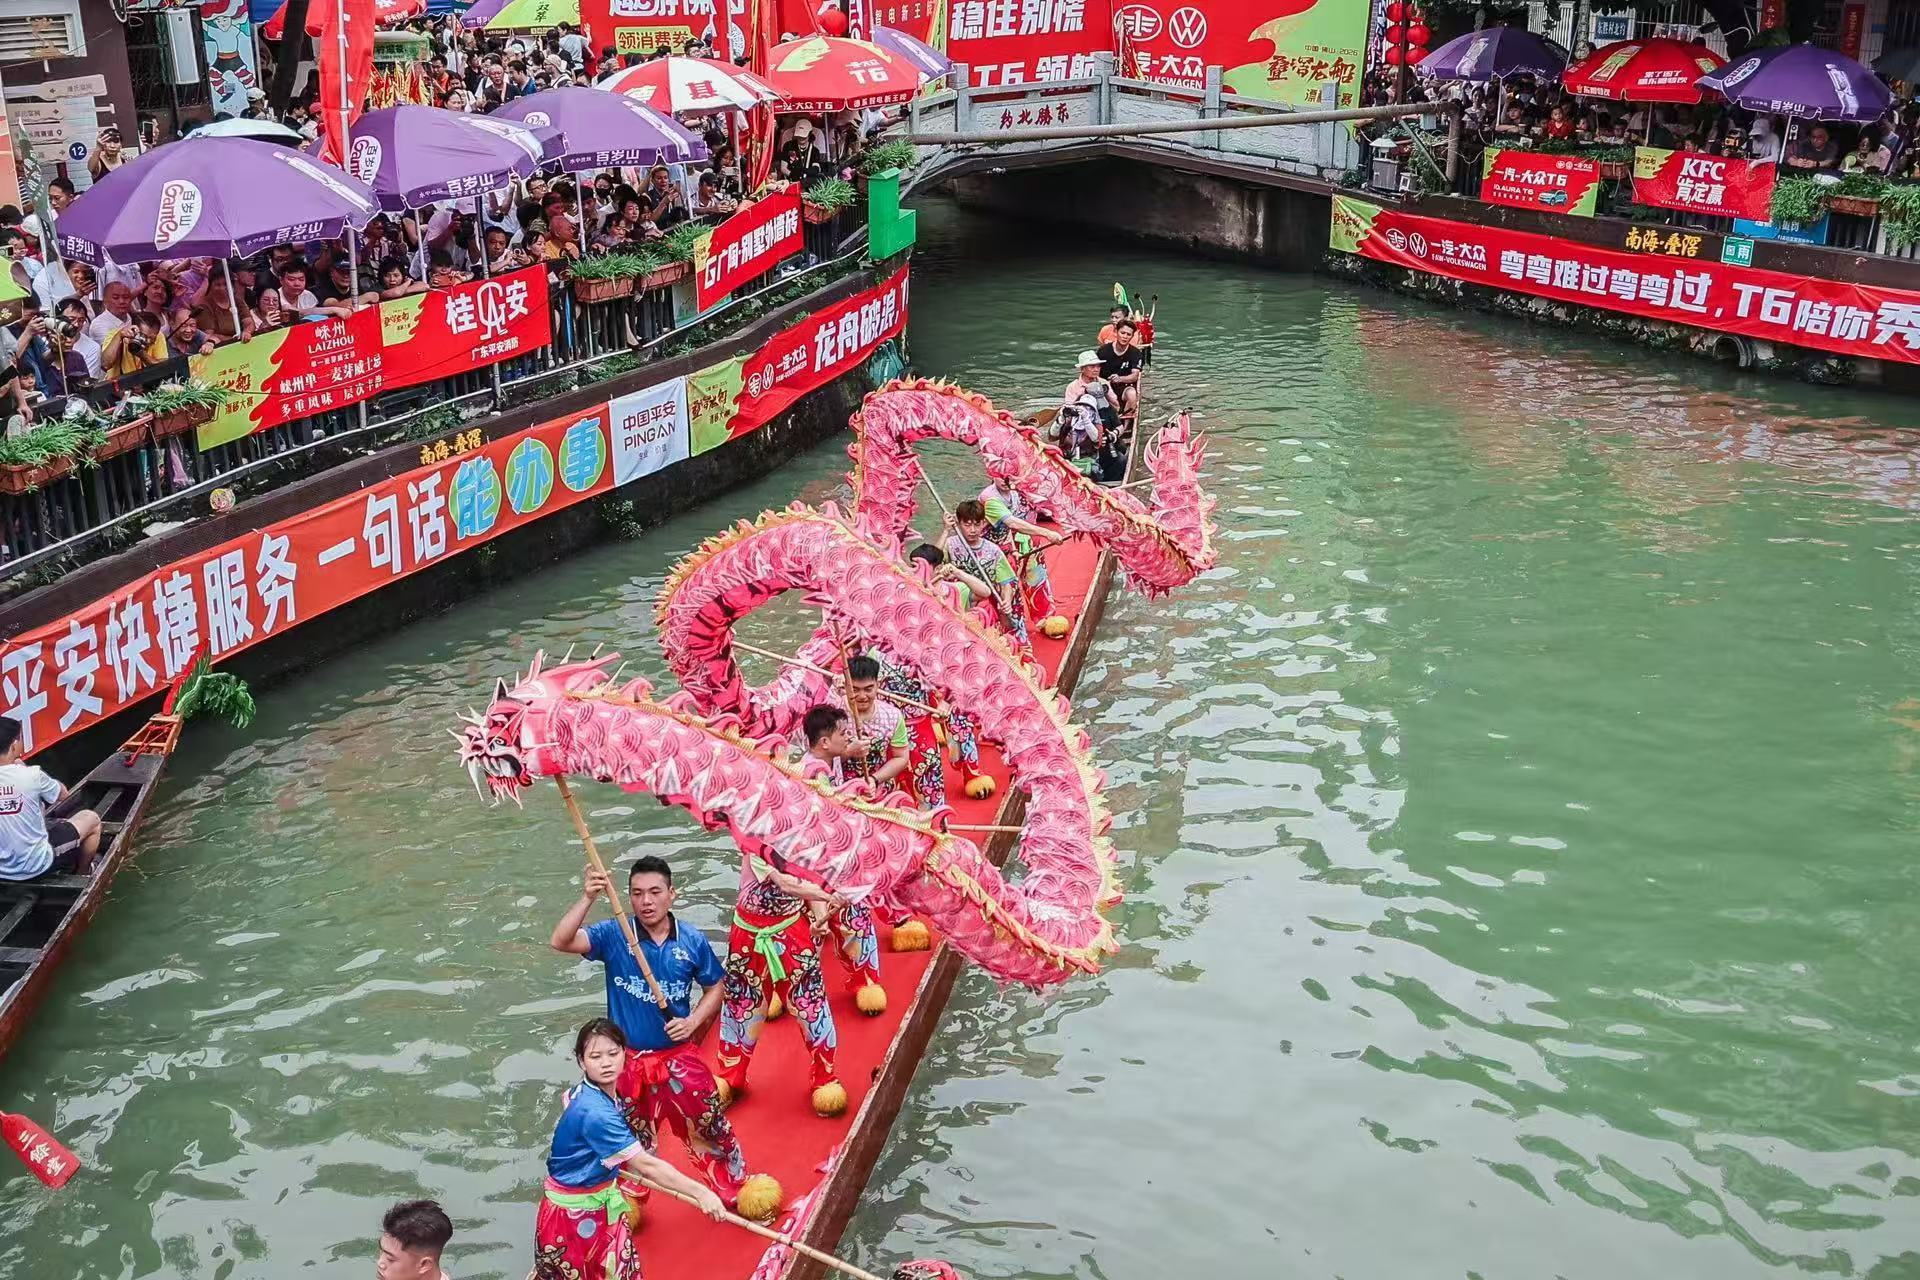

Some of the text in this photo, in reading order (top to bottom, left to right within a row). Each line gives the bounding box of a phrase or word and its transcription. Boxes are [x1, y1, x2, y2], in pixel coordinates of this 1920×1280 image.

[950, 0, 1085, 40] 稳住别慌
[848, 67, 889, 84] T6
[1137, 53, 1204, 78] 汽-大众
[1143, 76, 1204, 90] OLKSWAGEN
[816, 102, 834, 110] T6
[1304, 88, 1353, 107] 漂赛
[1770, 100, 1806, 113] 百岁山
[596, 149, 640, 162] 百岁山
[1495, 167, 1568, 187] 一汽-大众T6
[1680, 158, 1726, 181] KFC
[447, 173, 495, 193] 百岁山
[178, 190, 196, 226] 百岁山
[275, 221, 324, 240] 百岁山
[66, 235, 95, 255] 百岁山
[1430, 239, 1486, 262] 一汽-大众
[308, 335, 355, 354] LAIZHOU
[622, 400, 676, 431] 中国平安
[1, 417, 602, 754] 平安快捷服务 一句话能办事
